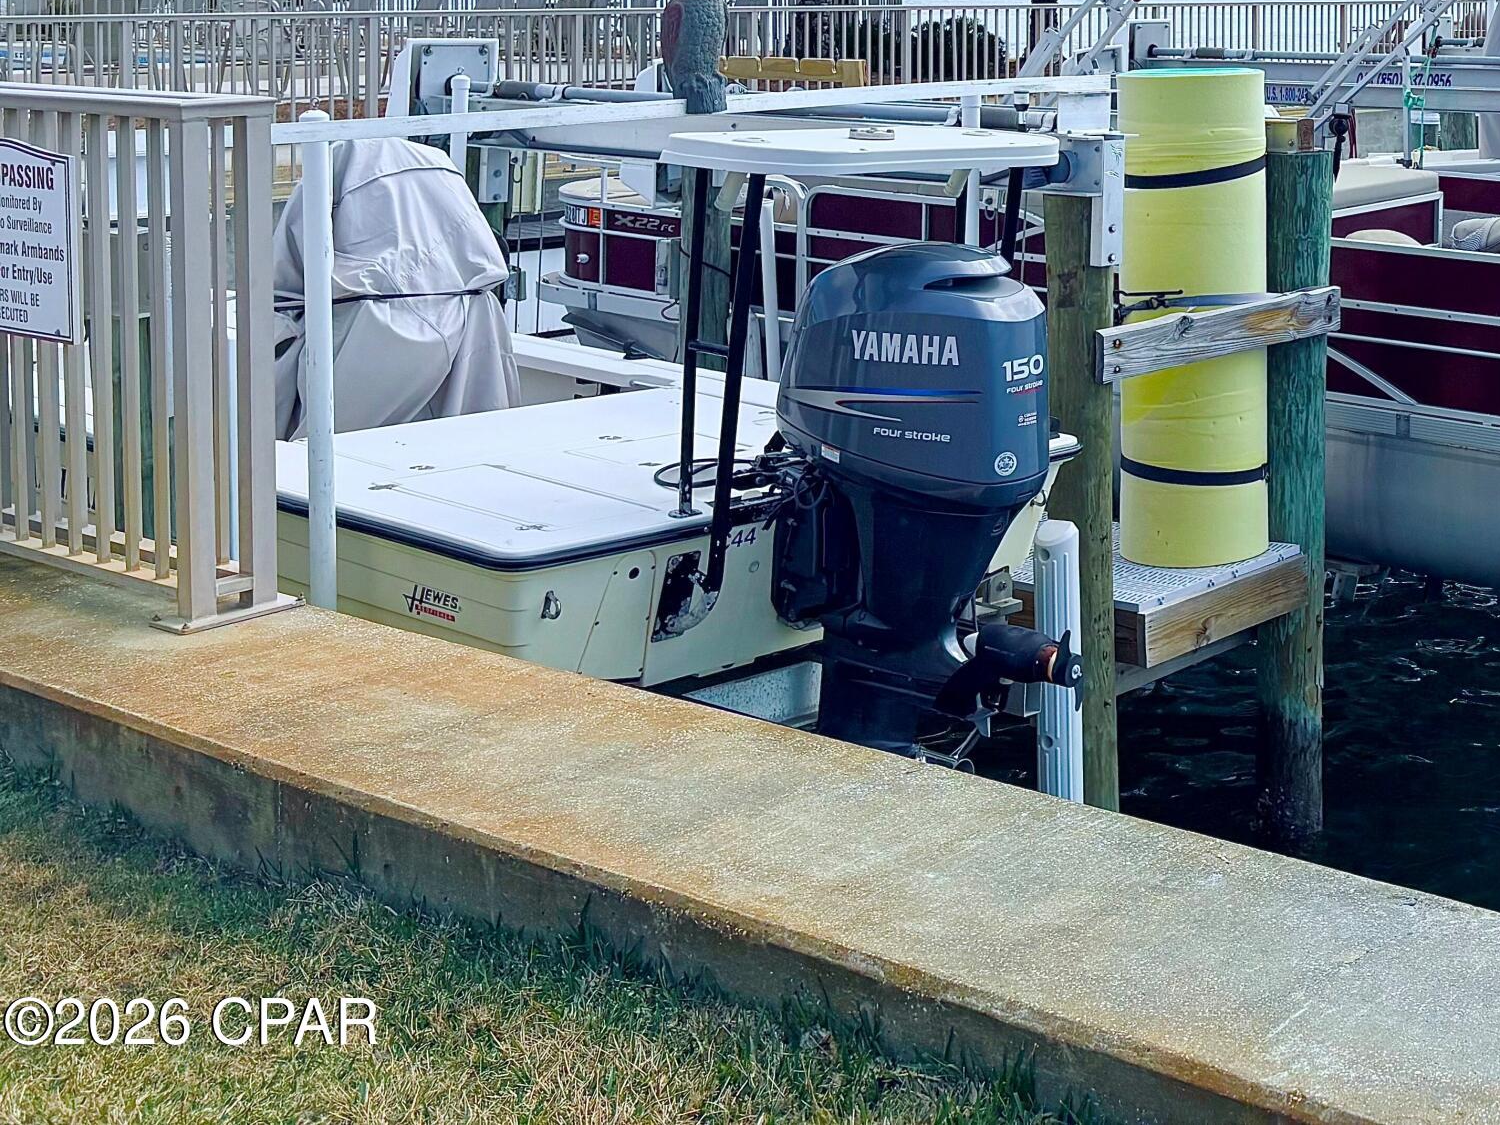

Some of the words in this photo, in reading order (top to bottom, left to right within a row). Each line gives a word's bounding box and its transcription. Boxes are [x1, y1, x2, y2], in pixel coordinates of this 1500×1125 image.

[1, 163, 54, 190] PASSING
[33, 196, 42, 215] By
[7, 215, 52, 234] Surveillance
[21, 240, 65, 262] Armbands
[12, 264, 53, 285] Entry/Use
[10, 289, 28, 306] WILL
[30, 293, 40, 307] BE
[851, 329, 960, 366] YAMAHA
[1002, 354, 1044, 382] 150
[402, 584, 459, 613] HEWES
